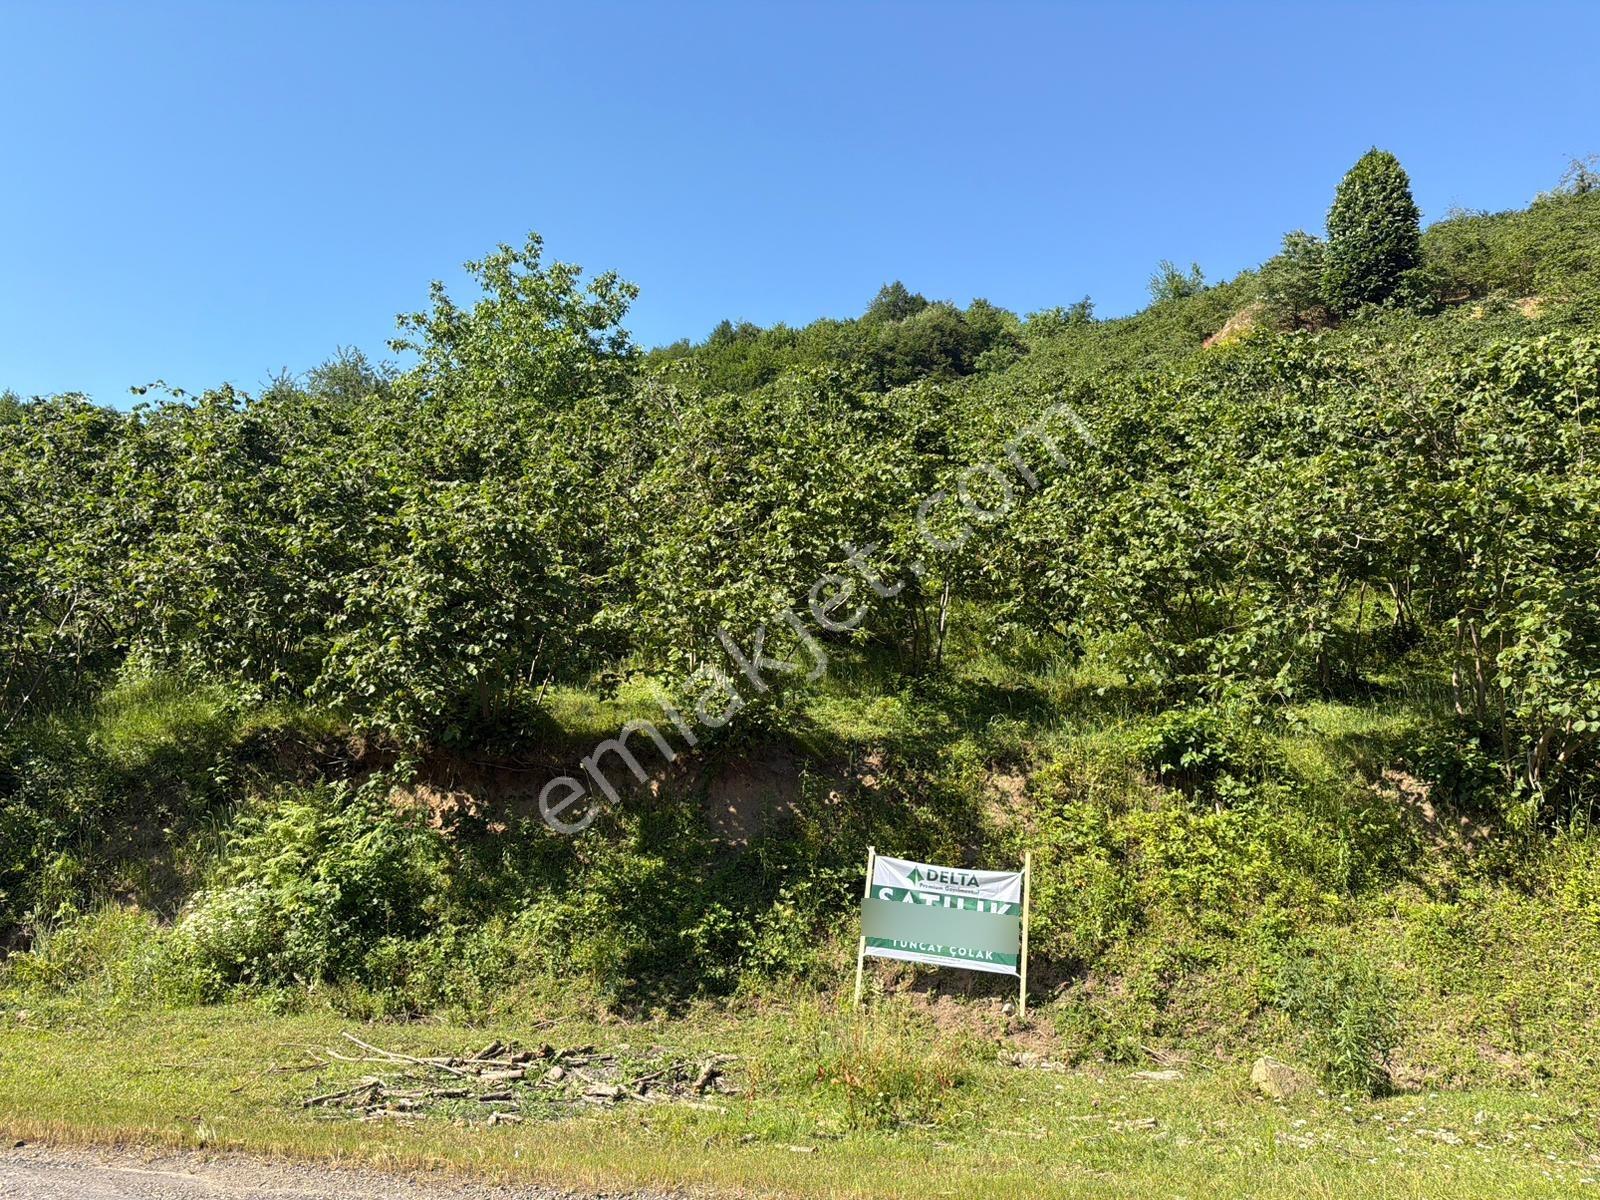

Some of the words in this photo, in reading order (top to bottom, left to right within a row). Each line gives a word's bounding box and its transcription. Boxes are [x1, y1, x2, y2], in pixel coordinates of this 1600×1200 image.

[926, 869, 980, 887] DELTA
[892, 939, 944, 953] TUNCAY
[949, 946, 994, 961] ÇOLAK
